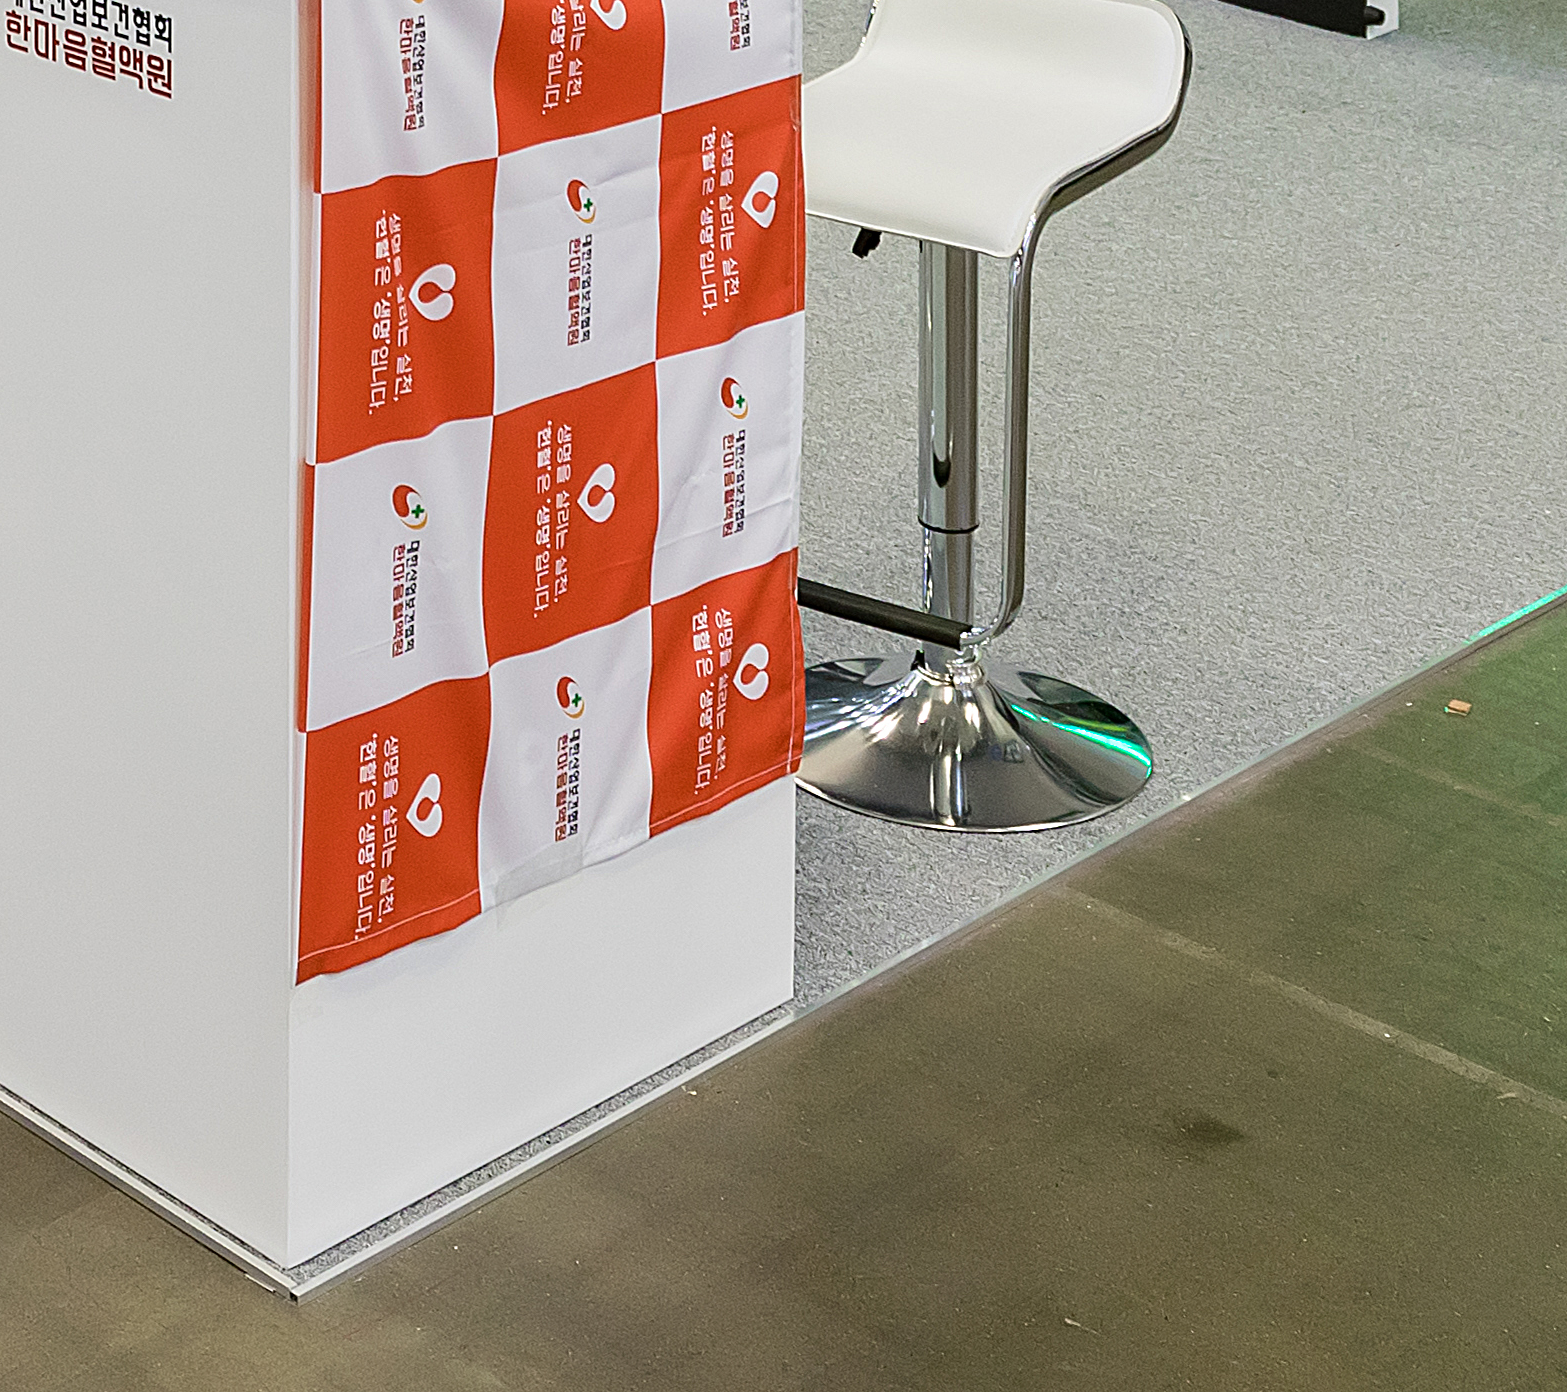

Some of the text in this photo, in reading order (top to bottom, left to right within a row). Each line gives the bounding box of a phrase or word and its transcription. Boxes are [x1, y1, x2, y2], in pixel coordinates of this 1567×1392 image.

[4, 9, 173, 100] 한마음혈액원
[399, 18, 417, 132] 한마음혈액원
[412, 15, 427, 130] 대한산업보건협회
[567, 58, 584, 103] 실천,
[718, 130, 740, 304] 생명을 살리는 실천,
[567, 238, 580, 347] 한마음혈액원
[580, 234, 593, 344] 대한산업보건협회
[553, 423, 572, 604] 생명을 살리는 실천,
[721, 434, 734, 539] 한마음혈액원
[734, 429, 747, 534] 대한산업보건협회
